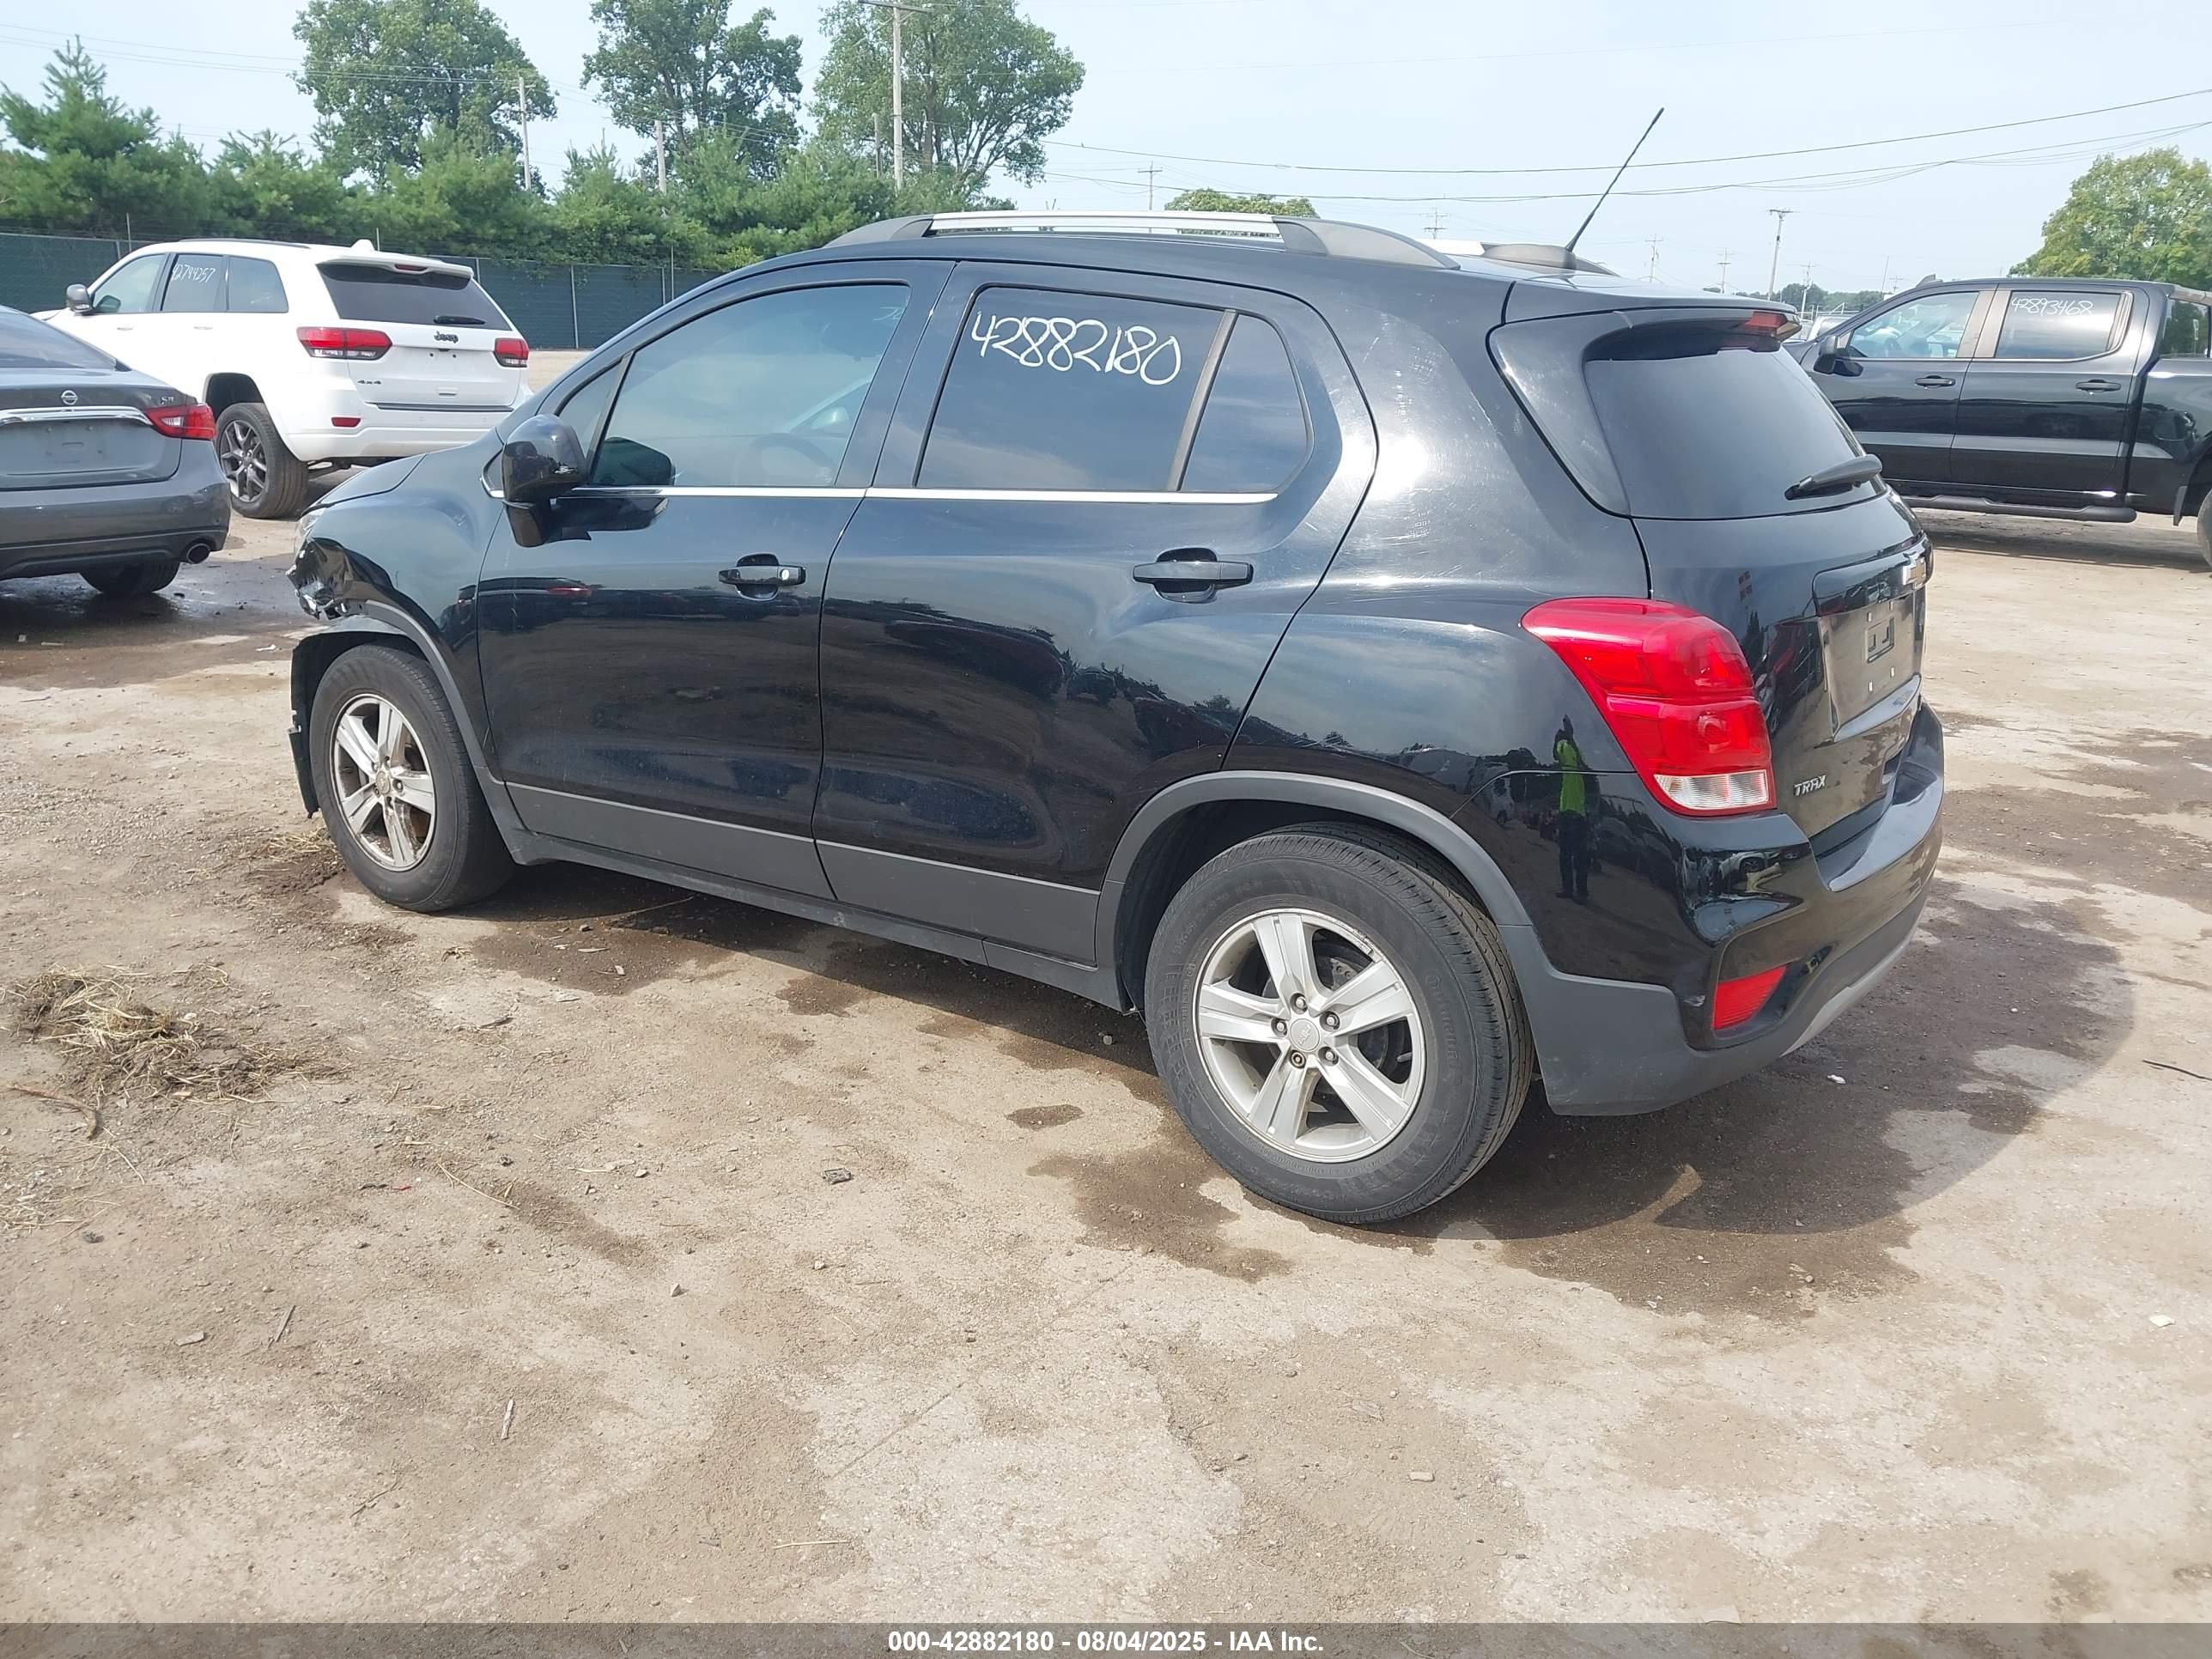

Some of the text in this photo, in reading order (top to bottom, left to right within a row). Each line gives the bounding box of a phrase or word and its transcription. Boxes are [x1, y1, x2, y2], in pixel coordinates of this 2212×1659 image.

[2011, 297, 2094, 317] 42893468
[434, 331, 459, 343] Jeep
[971, 311, 1182, 386] 42882180
[1793, 775, 1827, 797] TRAX
